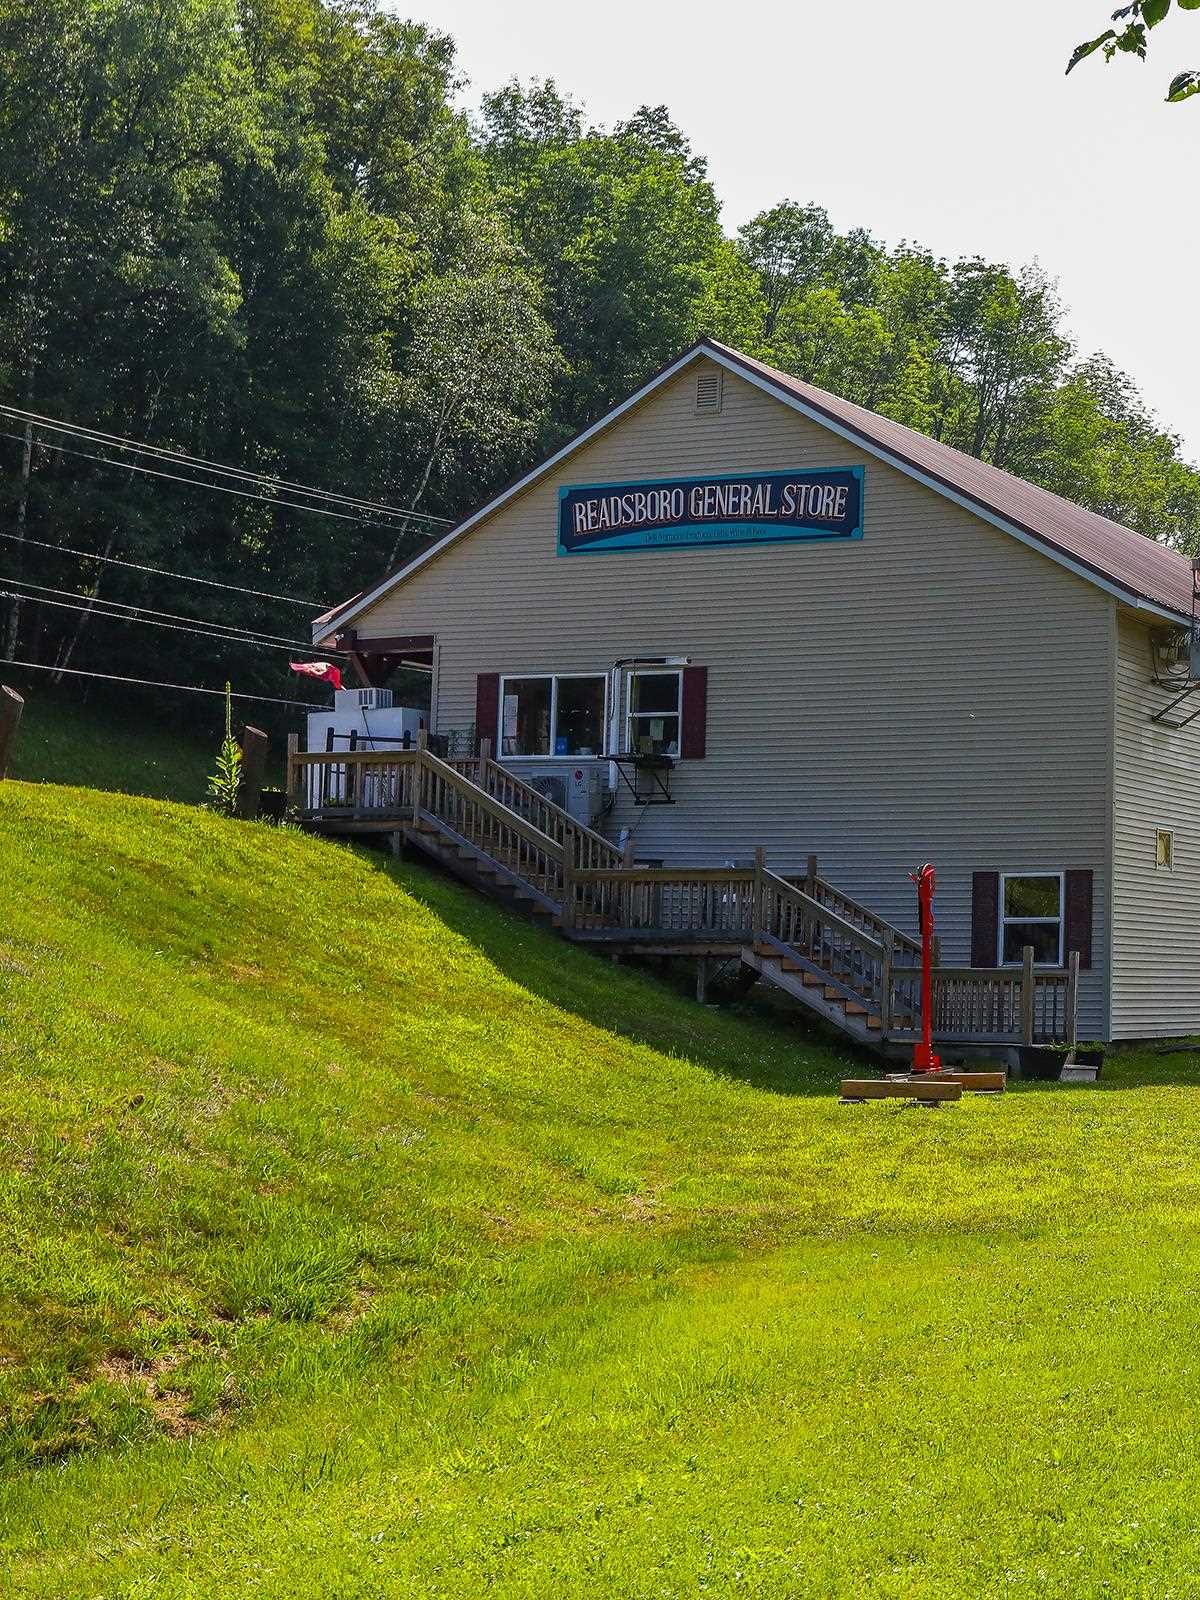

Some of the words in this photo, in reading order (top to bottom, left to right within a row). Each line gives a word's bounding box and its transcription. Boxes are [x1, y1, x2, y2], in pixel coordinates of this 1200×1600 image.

[574, 488, 684, 534] READSBORO
[689, 484, 777, 518] GENERAL
[781, 484, 849, 519] STORE
